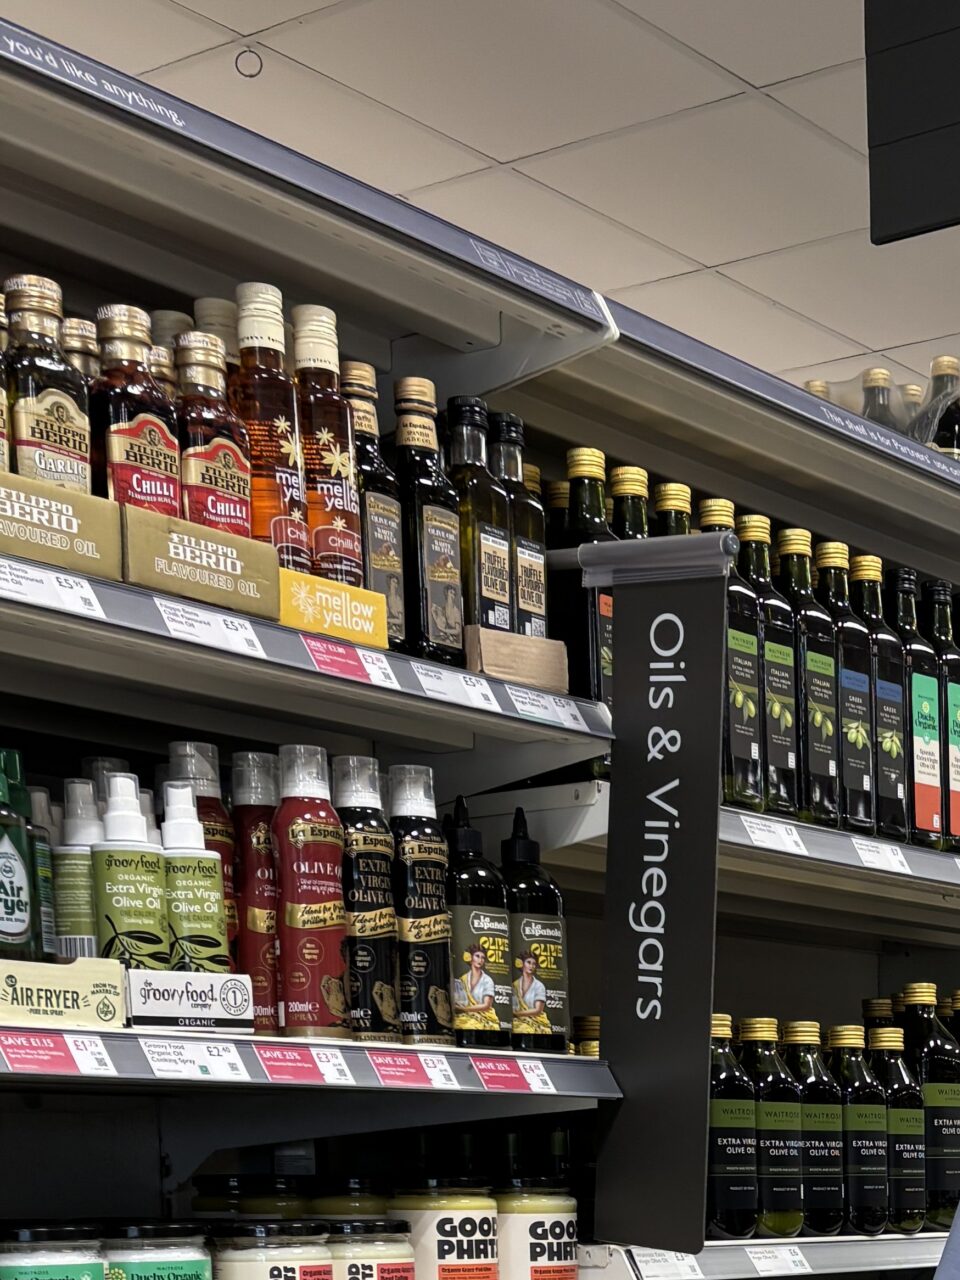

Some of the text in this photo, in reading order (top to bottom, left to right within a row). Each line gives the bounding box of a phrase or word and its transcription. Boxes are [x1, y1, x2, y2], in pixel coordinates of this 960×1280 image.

[3, 36, 186, 127] you'd like anything.
[30, 426, 88, 454] BERIO
[35, 419, 86, 441] FILIPPO
[34, 450, 87, 479] GARLIC
[125, 442, 178, 476] FILIPPO BERIO
[132, 473, 174, 497] CHILLI
[204, 465, 249, 485] FILIPPO
[0, 487, 73, 516] FILIPPO
[208, 495, 246, 519] CHILLI
[0, 499, 78, 533] BERIO
[0, 520, 100, 559] AVOURED OIL
[169, 531, 237, 558] FILIPPO
[168, 541, 241, 574] BERIO
[484, 551, 506, 569] TRUFFLE
[155, 557, 260, 598] FLAVOURED OIL
[483, 575, 507, 594] OLIVE OIL
[315, 591, 374, 618] mellow
[323, 604, 374, 634] yellow
[628, 613, 687, 1020] Oils & Vinegars
[105, 882, 164, 897] Extra Virgin
[117, 873, 155, 882] ORGANIC
[112, 896, 161, 909] Olive Oil
[479, 936, 509, 951] OLIVE
[486, 950, 504, 963] OIL
[11, 987, 80, 1010] AIR FRYER
[178, 1018, 216, 1027] ORGANIC
[717, 1138, 740, 1146] EXTRA
[726, 1146, 745, 1154] OLIVE
